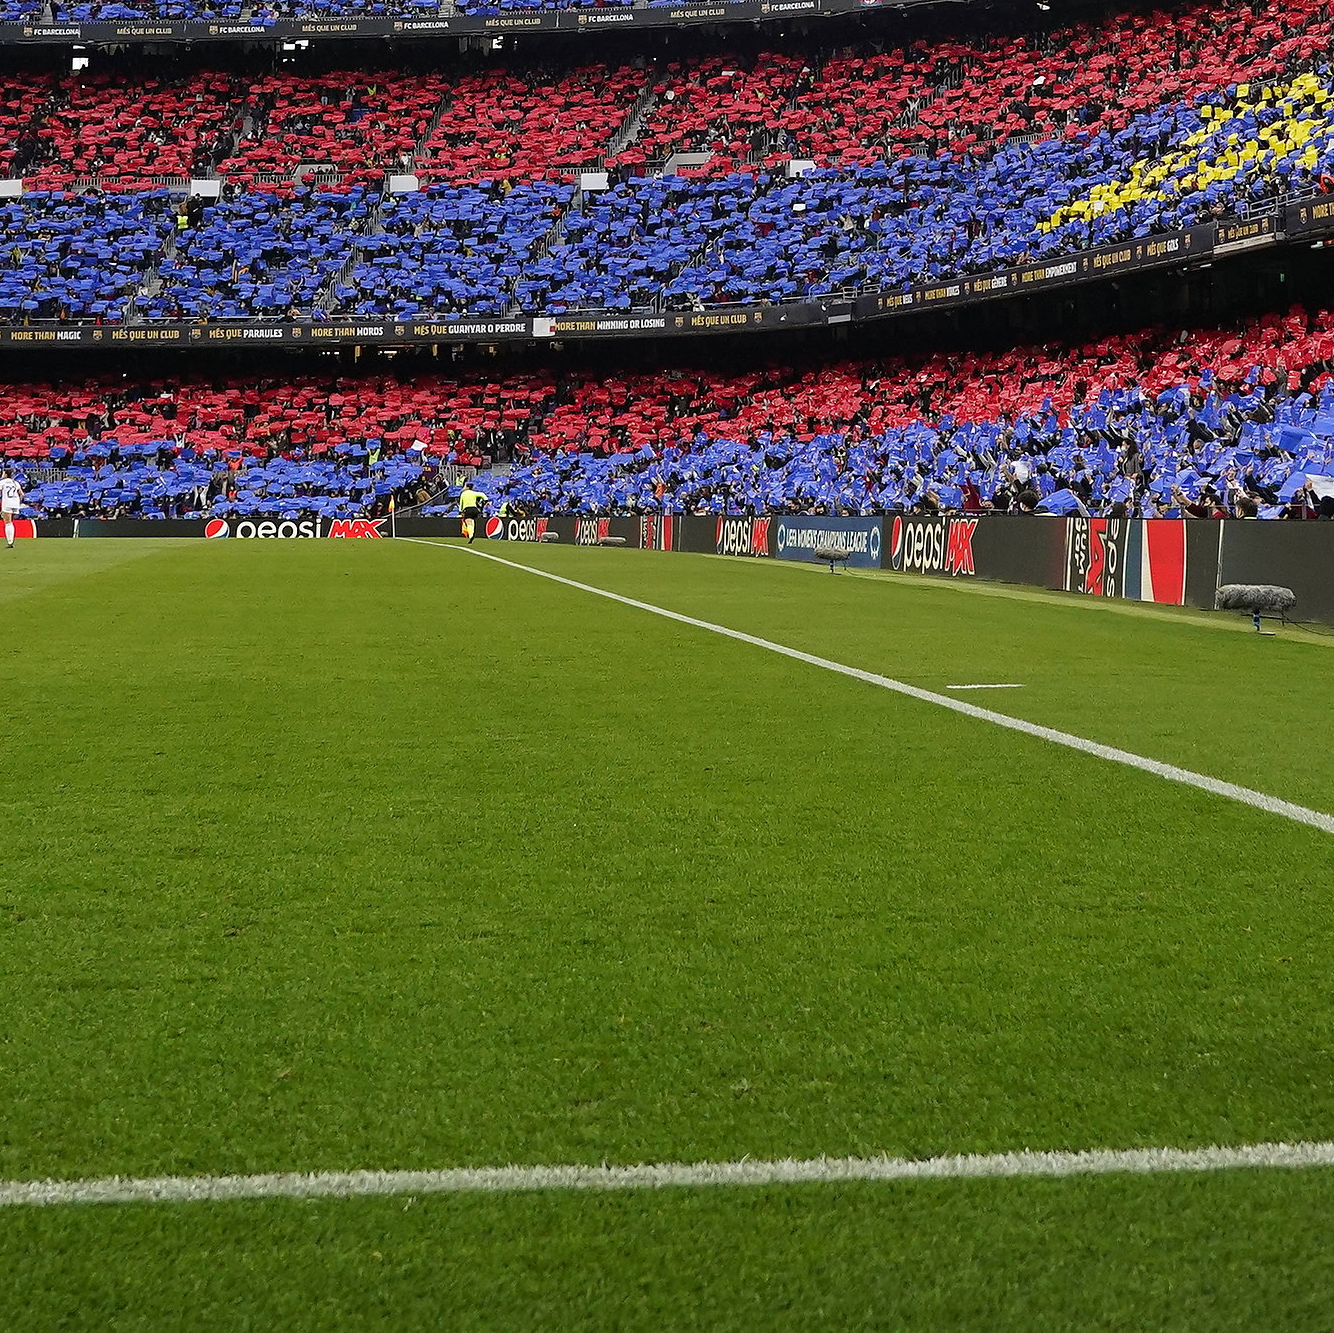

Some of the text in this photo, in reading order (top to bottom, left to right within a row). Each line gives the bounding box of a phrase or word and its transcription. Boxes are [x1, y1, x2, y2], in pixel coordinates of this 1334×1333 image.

[779, 2, 815, 11] BARCELONA
[1313, 202, 1327, 218] MORE
[555, 318, 665, 332] MORE THAN WINNING OR LOSING
[691, 314, 747, 326] MÉS QUE UN CLUB
[11, 331, 81, 339] MORE THAN MAGIC
[112, 329, 179, 341] MÉS QUE UN CLUB
[209, 327, 283, 339] MÉS QUE PARAULES
[311, 326, 383, 336] MORE THAN WORDS
[414, 323, 525, 335] MÉS QUE GUANYAR O PERDRE
[236, 518, 388, 539] pepsi MAX
[723, 516, 751, 556] pepsi
[786, 528, 797, 547] UEFA
[817, 530, 846, 549] CHAMPIONS
[846, 531, 868, 552] LEAGUE
[903, 517, 979, 577] pepsi MAX
